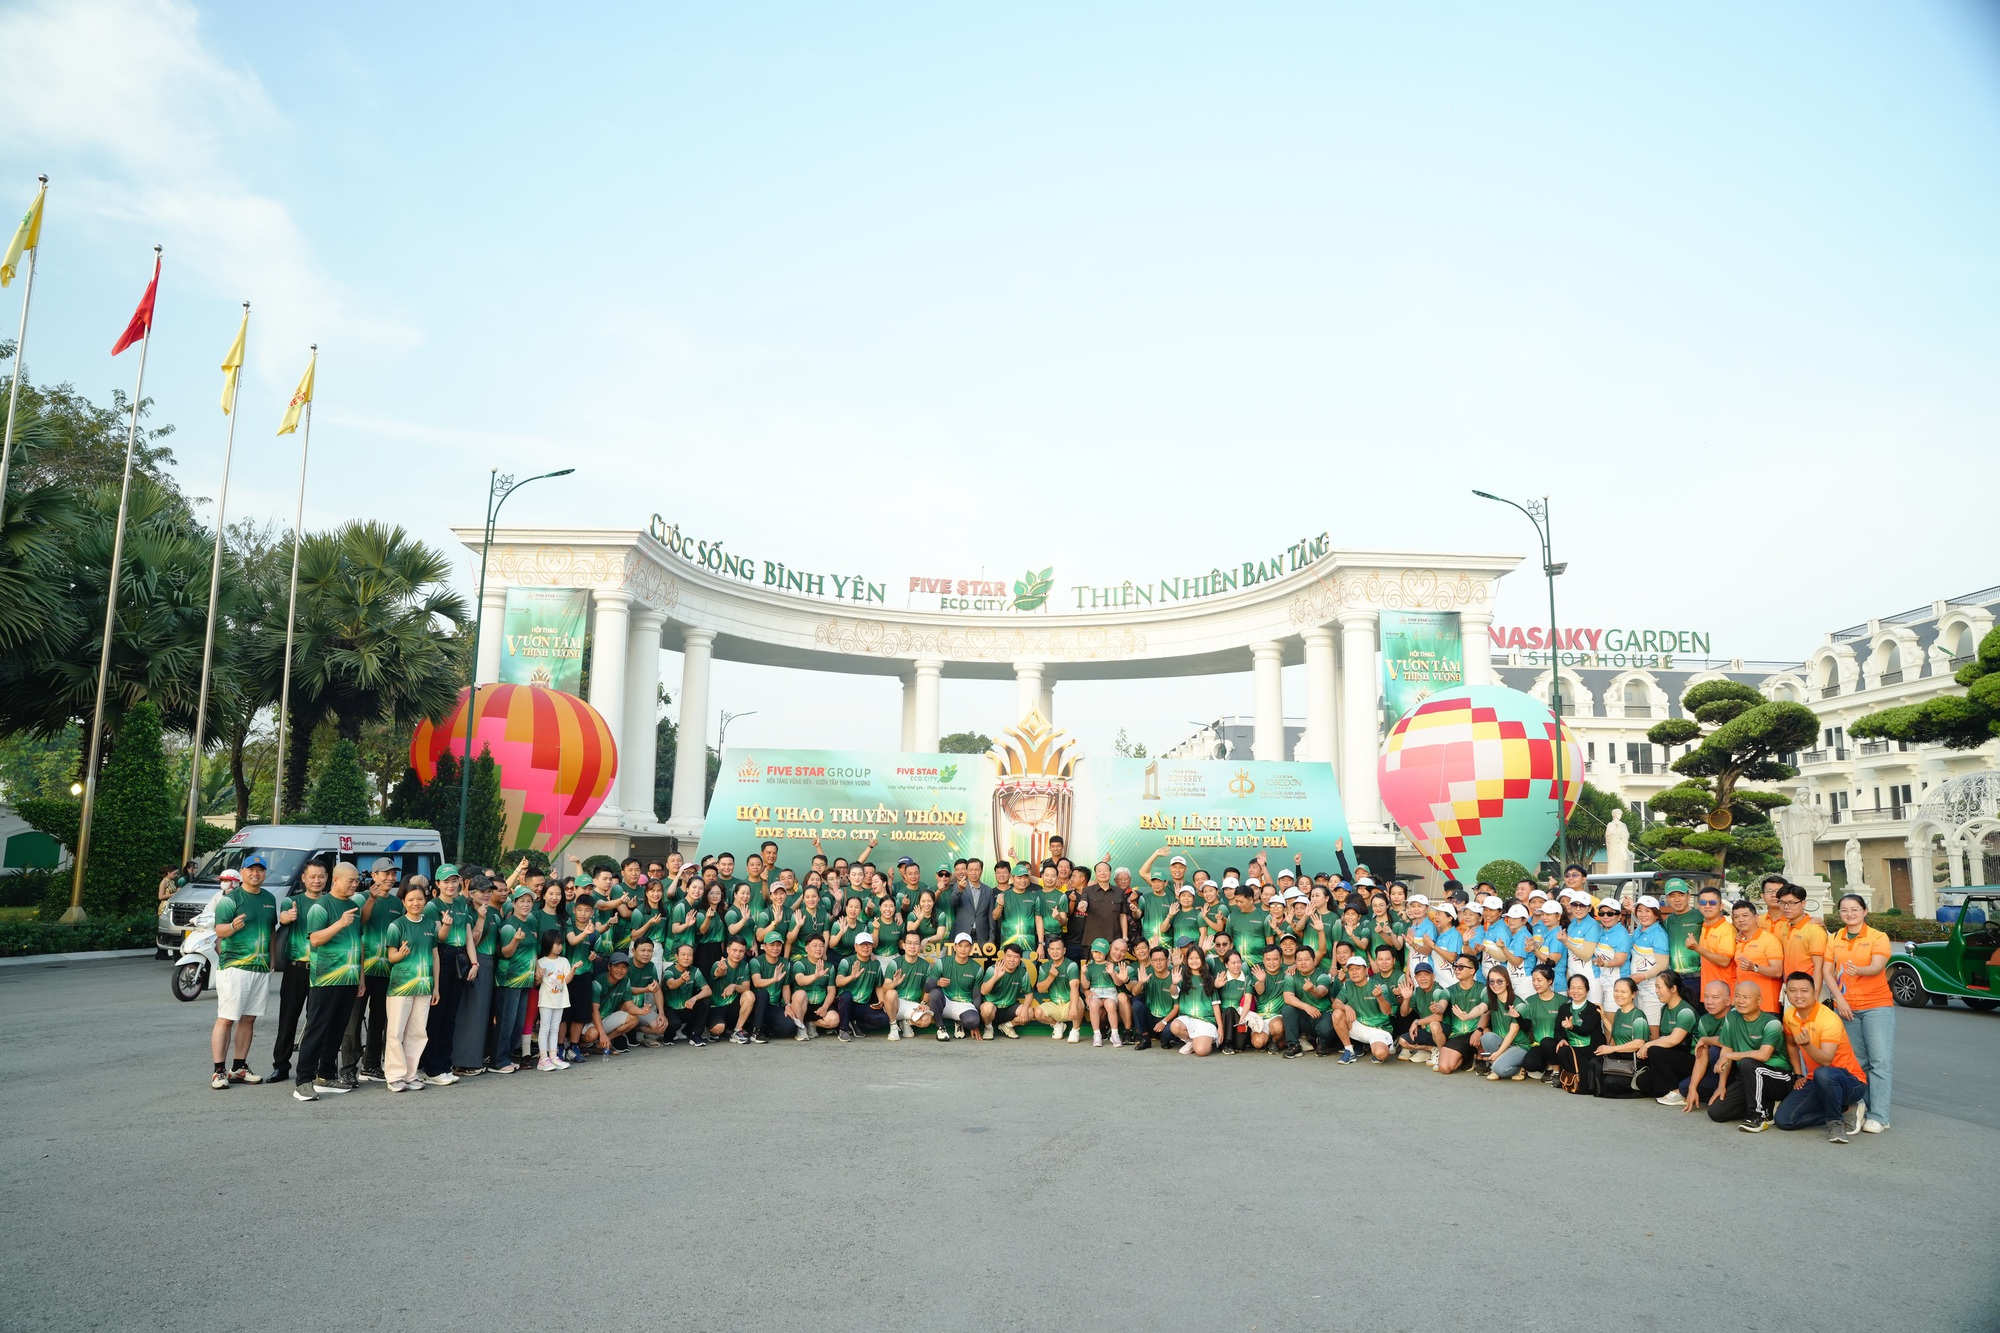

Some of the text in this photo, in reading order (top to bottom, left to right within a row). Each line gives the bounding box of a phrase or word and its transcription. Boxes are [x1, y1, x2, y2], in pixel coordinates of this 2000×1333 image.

[830, 574, 887, 604] YÊN
[909, 576, 1007, 597] FIVE STAR
[1071, 580, 1154, 609] THIÊN
[1159, 568, 1238, 602] NHIÊN
[1242, 554, 1284, 587] BAN
[941, 597, 1007, 611] ECO CITY
[1488, 626, 1710, 653] NASAKY GARDEN
[767, 766, 871, 778] FIVE STAR GROUP
[896, 767, 938, 776] FIVE STAR
[1167, 774, 1203, 782] ODYSSEY
[736, 802, 968, 827] HỘI THAO TRUYỀN THỐNG
[1139, 810, 1313, 832] BẢN LĨNH FIVE STAR
[755, 827, 785, 839] FIVE
[786, 827, 817, 839] STAR
[821, 828, 847, 840] ECO
[850, 829, 879, 841] CITY
[890, 830, 946, 842] 10.01.2026
[1165, 832, 1288, 849] TINH THẦN BỨT PHÁ
[944, 942, 997, 957] TAO
